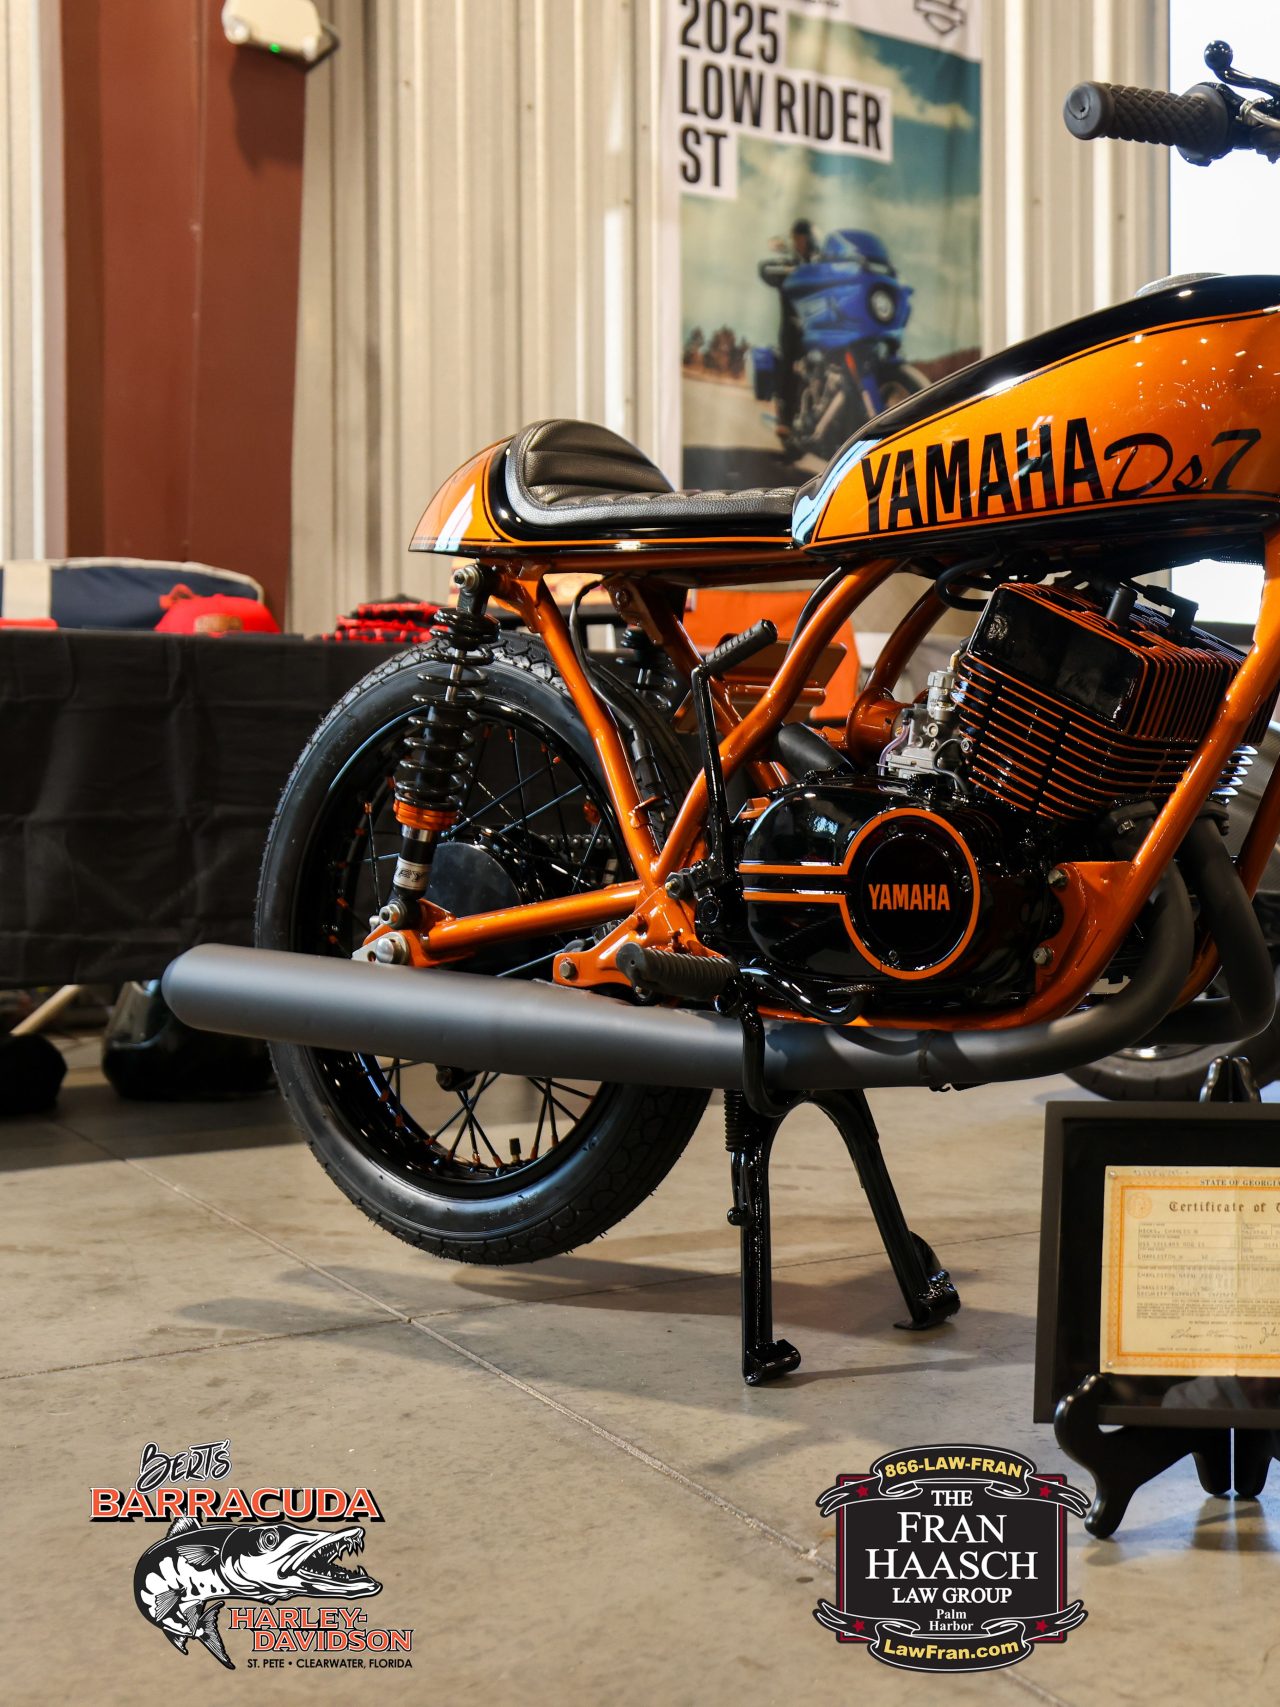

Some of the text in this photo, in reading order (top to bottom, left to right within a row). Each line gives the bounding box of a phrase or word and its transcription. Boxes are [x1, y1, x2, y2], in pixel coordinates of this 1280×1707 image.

[680, 0, 779, 64] 2025
[680, 58, 882, 151] LOW RIDER
[680, 127, 727, 188] ST
[861, 417, 1262, 533] YAMAHA Ds7
[868, 884, 951, 911] YAMAHA
[1169, 1201, 1244, 1213] Certificate
[1253, 1202, 1266, 1213] of
